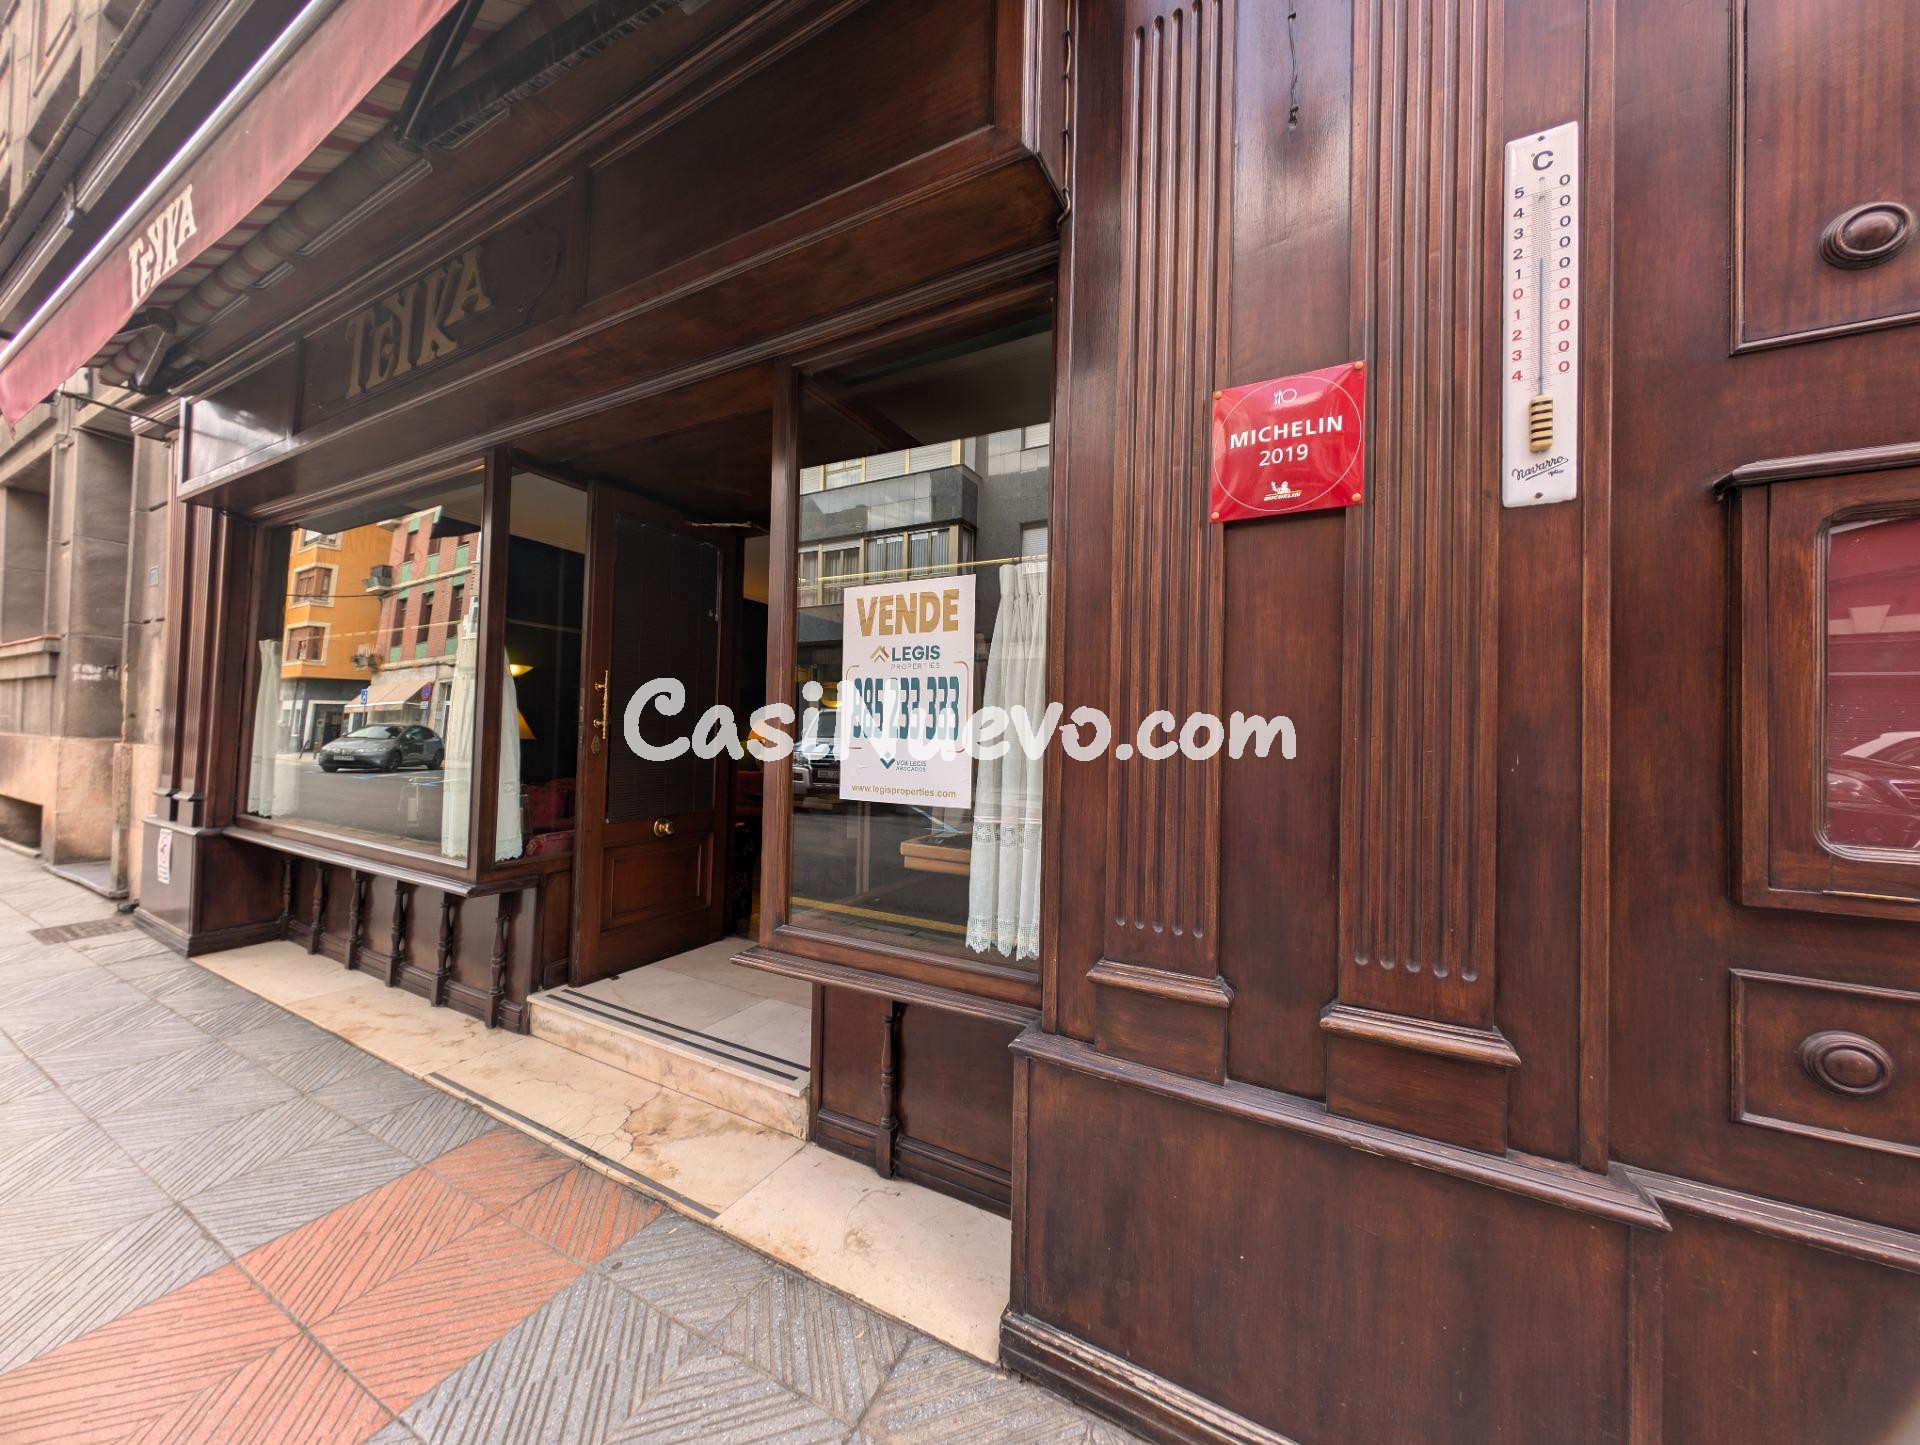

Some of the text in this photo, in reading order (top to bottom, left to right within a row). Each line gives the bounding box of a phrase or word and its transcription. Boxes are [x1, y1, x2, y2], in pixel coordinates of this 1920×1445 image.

[1514, 174, 1571, 199] 5 0
[1513, 195, 1571, 219] 4 0
[1513, 215, 1571, 240] 3 0
[1513, 236, 1571, 260] 2 0
[1514, 257, 1571, 279] 1 0
[1512, 277, 1570, 300] 0 0
[1513, 298, 1570, 320] 1 0
[1512, 319, 1570, 341] 2 0
[1511, 340, 1570, 361] 3 0
[1511, 361, 1570, 381] 4 0
[1230, 415, 1343, 449] MICHELIN
[1259, 444, 1309, 467] 2019
[1263, 491, 1302, 501] MICHELIN
[856, 589, 960, 637] VENDE
[891, 645, 941, 662] LEGIS
[890, 661, 941, 671] PROPERTIES
[853, 676, 959, 741] 985 233 333
[851, 784, 957, 798] www.legisproperties.com
